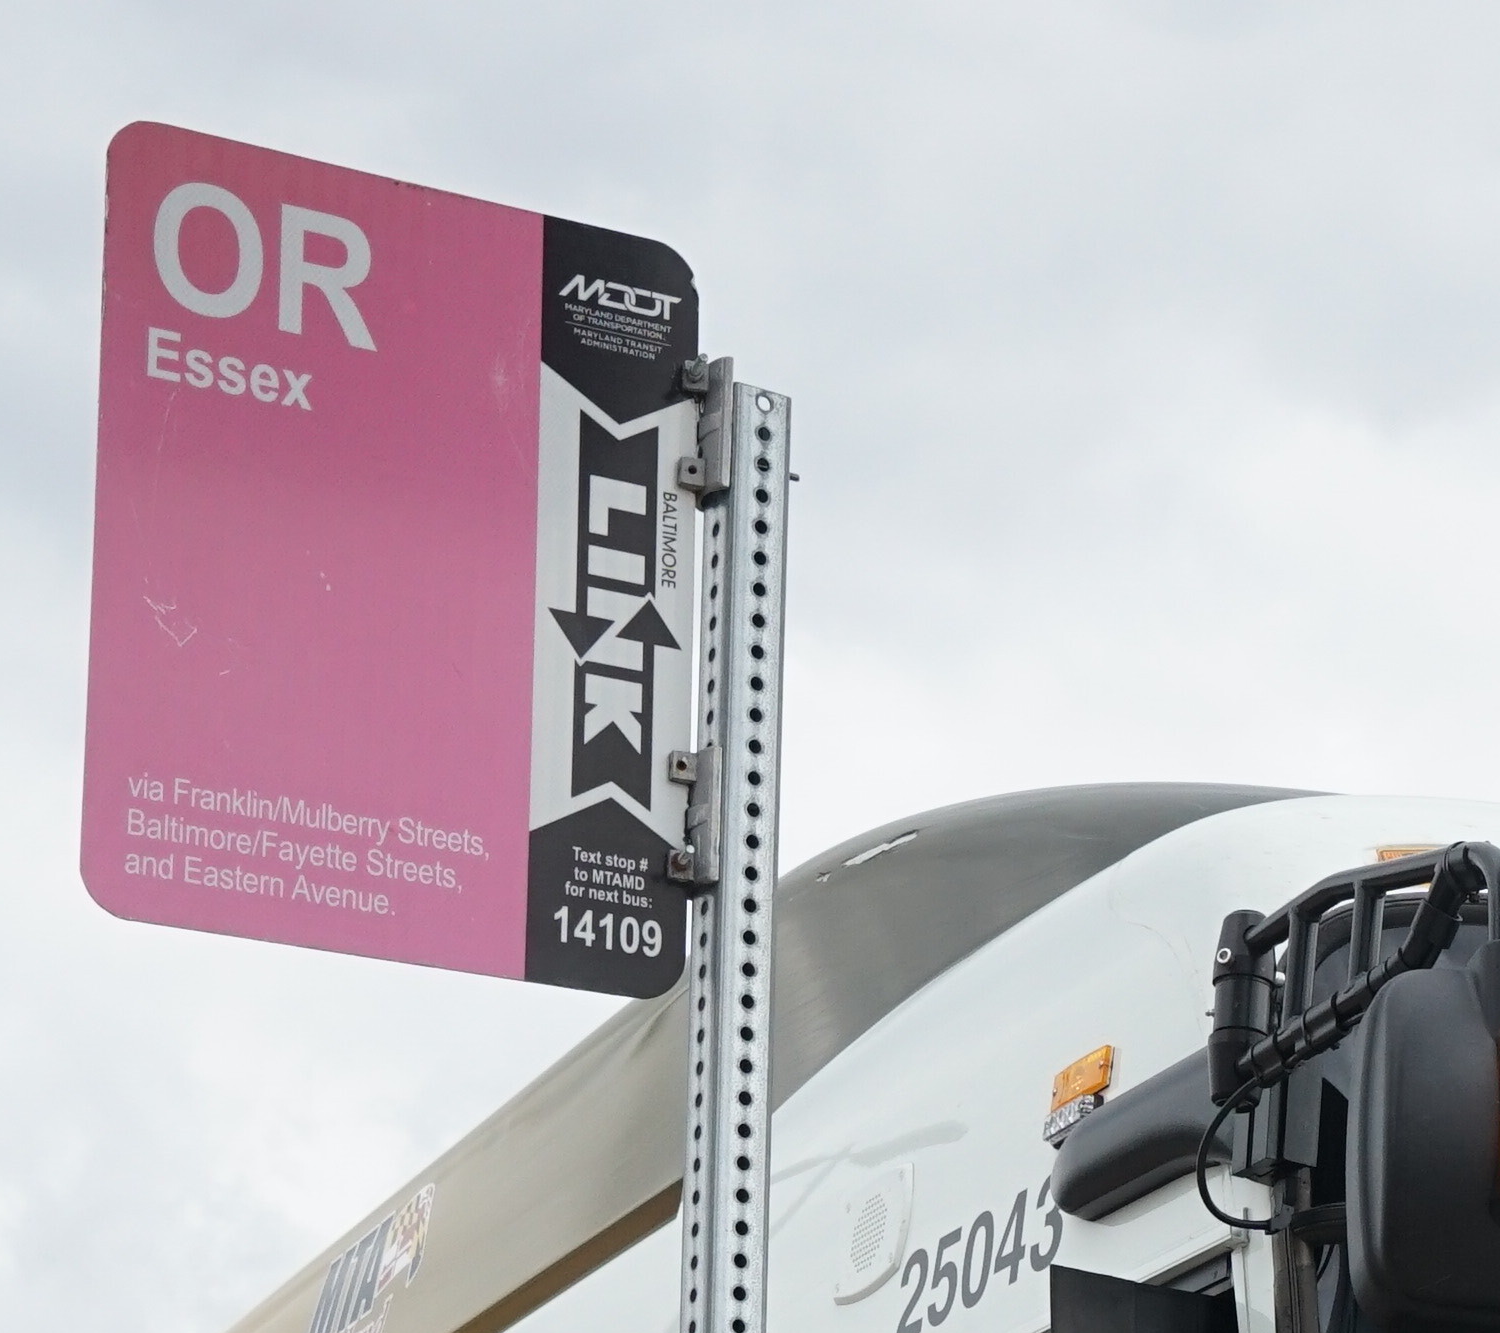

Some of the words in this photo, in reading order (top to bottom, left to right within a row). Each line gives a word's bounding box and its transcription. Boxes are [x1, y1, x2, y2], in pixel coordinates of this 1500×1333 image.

[153, 182, 378, 352] OR
[558, 273, 682, 320] MDOT
[564, 302, 614, 321] MARYLAND
[614, 314, 673, 334] DEPARTMENT
[572, 313, 586, 322] OF
[573, 327, 624, 345] MARYLAND
[626, 338, 663, 354] TRANSIT
[580, 337, 656, 361] ADMINISTRATION
[147, 326, 313, 411] Essex
[660, 490, 678, 590] BALTIMORE
[582, 473, 648, 755] LINK
[128, 772, 164, 802] via
[173, 777, 391, 846] Franklin/Mulberry
[397, 816, 491, 861] Streets,
[126, 808, 358, 872] Baltimore/Fayette
[366, 849, 463, 894] Streets,
[572, 845, 602, 865] Text
[605, 853, 636, 873] stop
[639, 857, 649, 873] #
[124, 853, 174, 880] and
[183, 855, 285, 898] Eastern
[291, 875, 397, 917] Avenue.
[564, 880, 586, 898] for
[588, 887, 619, 904] next
[622, 890, 653, 909] bus:
[573, 866, 589, 882] to
[592, 868, 646, 891] MTAMD
[553, 905, 663, 958] 14109
